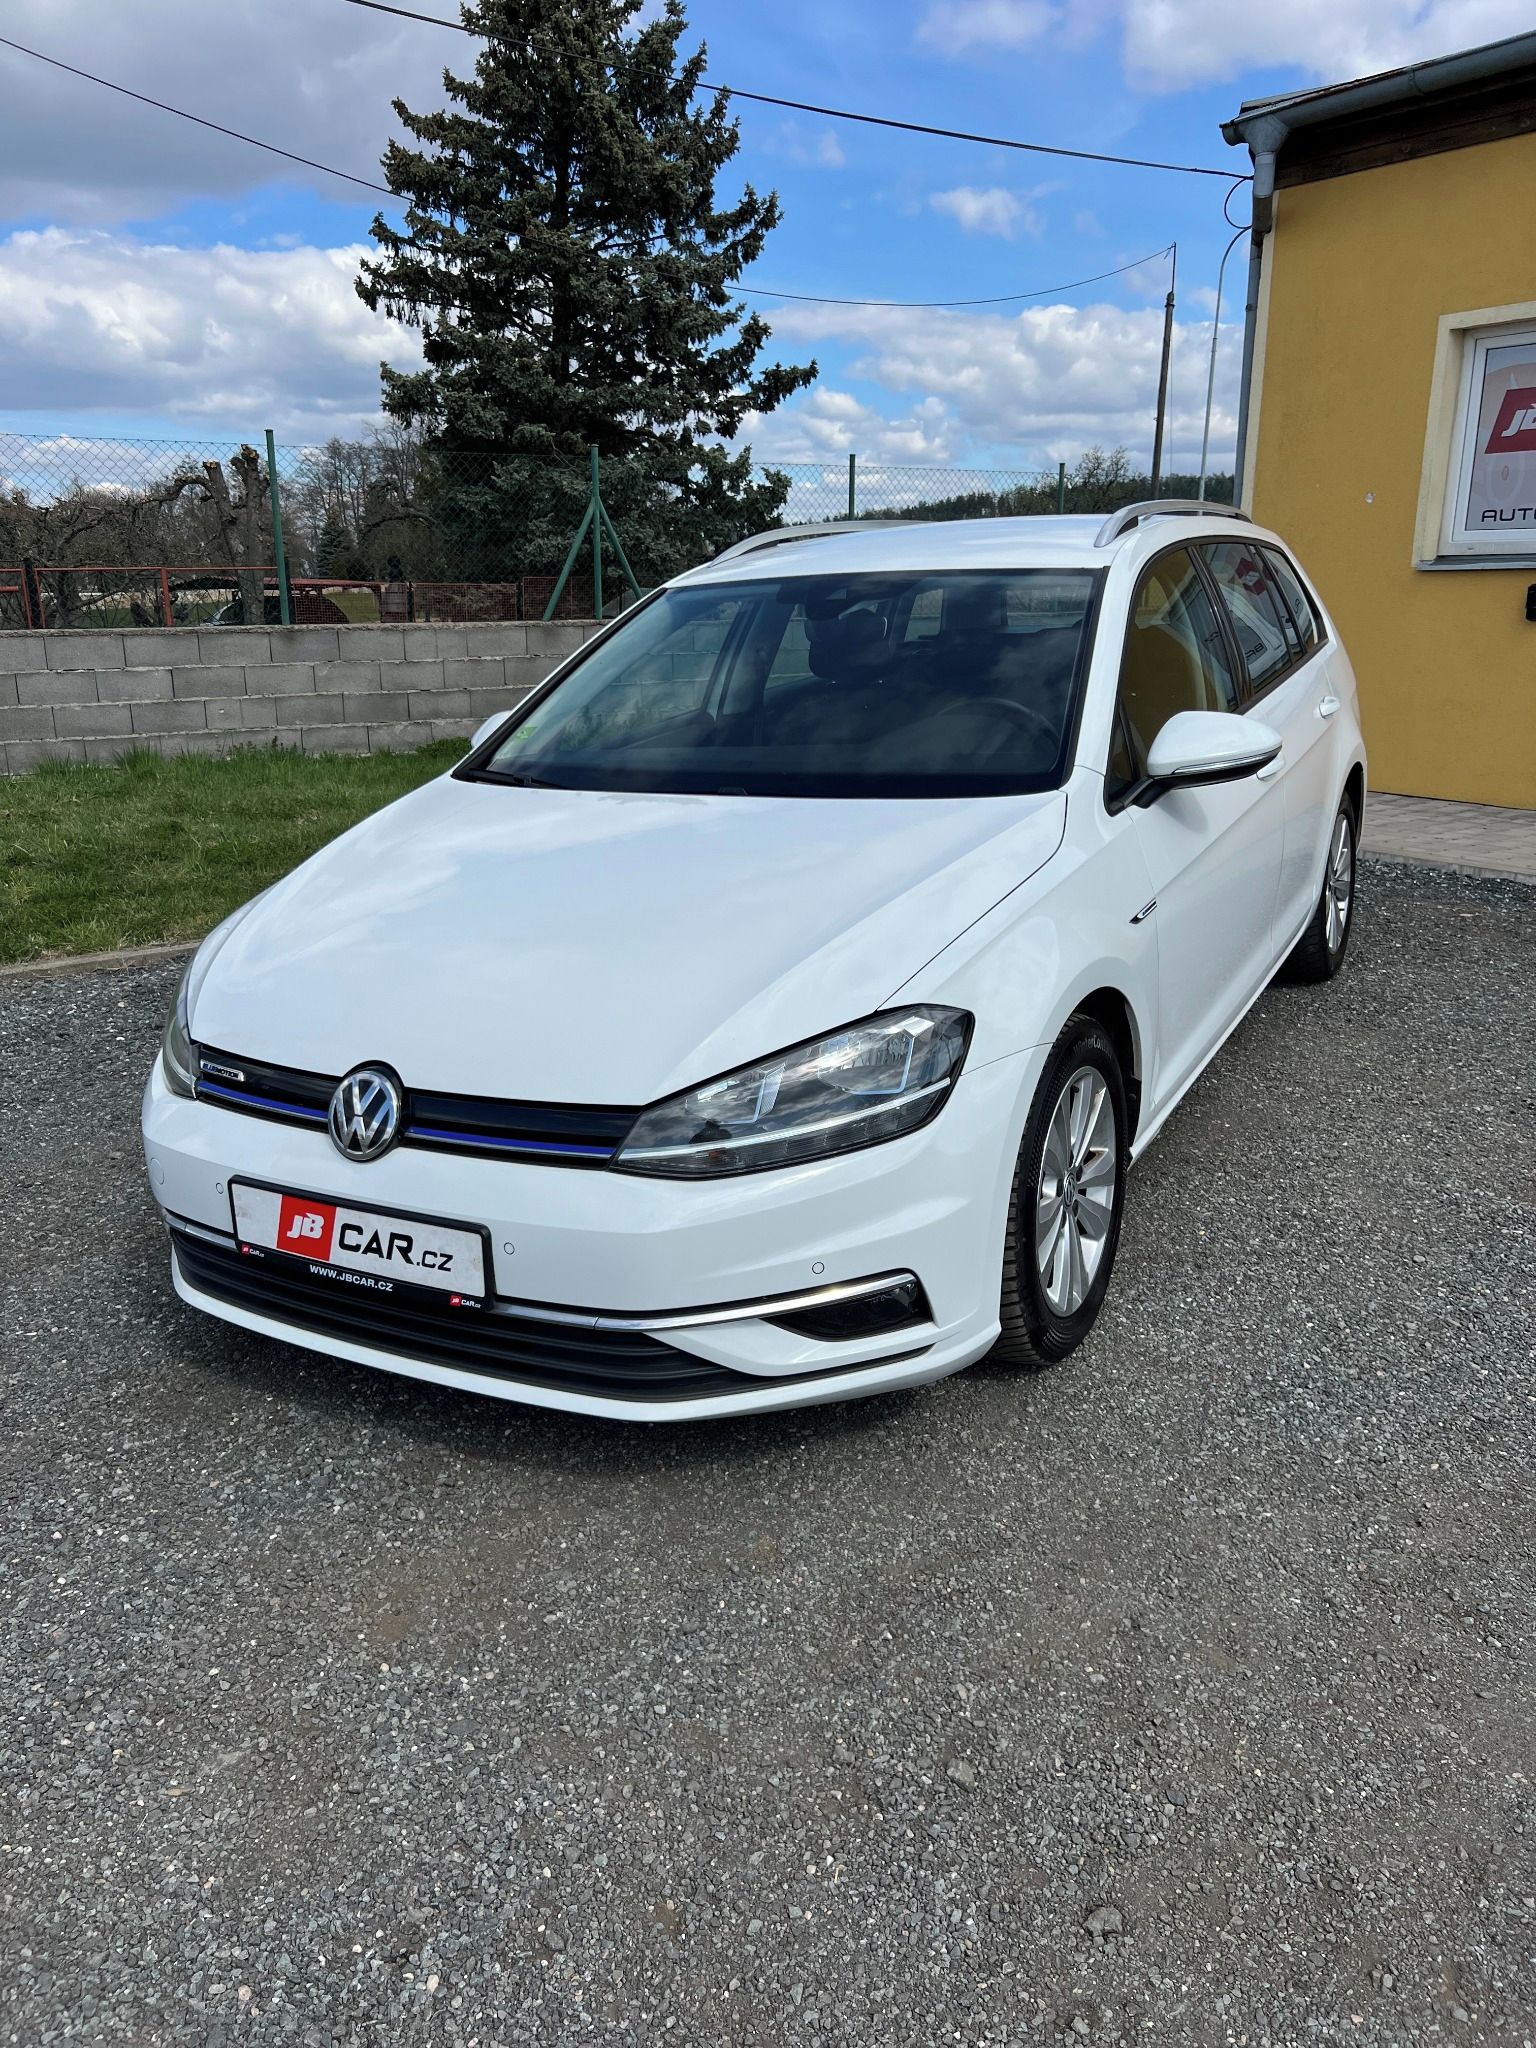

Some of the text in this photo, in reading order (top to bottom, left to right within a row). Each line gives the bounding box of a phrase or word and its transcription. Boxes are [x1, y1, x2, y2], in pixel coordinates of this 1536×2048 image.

[1481, 507, 1536, 522] AUT
[287, 1212, 325, 1240] JB
[309, 1264, 393, 1292] WWW.JBCAR.CZ
